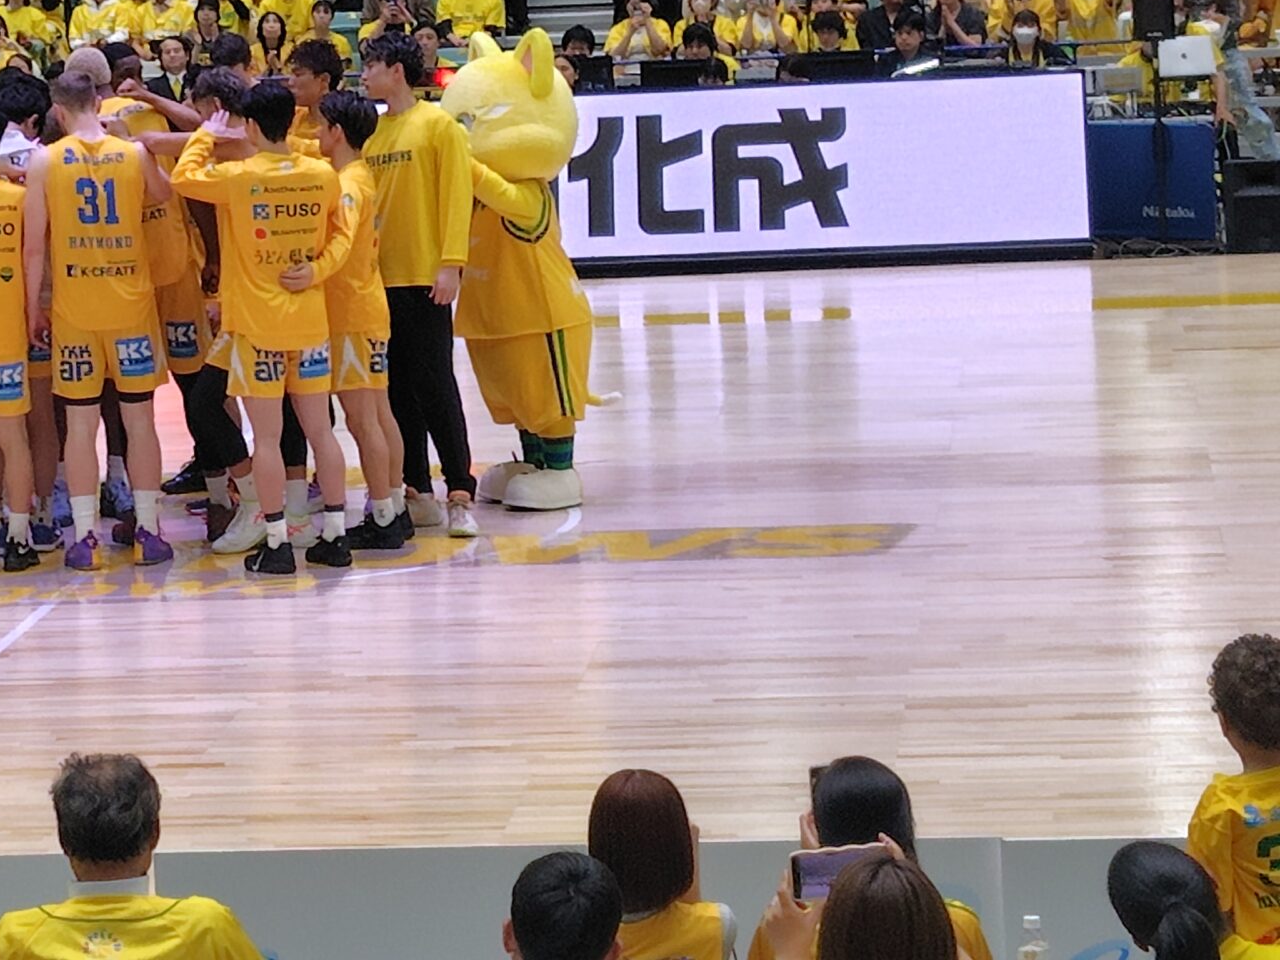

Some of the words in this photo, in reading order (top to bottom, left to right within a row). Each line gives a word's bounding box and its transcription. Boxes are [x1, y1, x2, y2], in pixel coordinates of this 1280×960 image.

[568, 107, 850, 237] 化成
[76, 177, 120, 225] 31
[275, 203, 321, 219] FUSO
